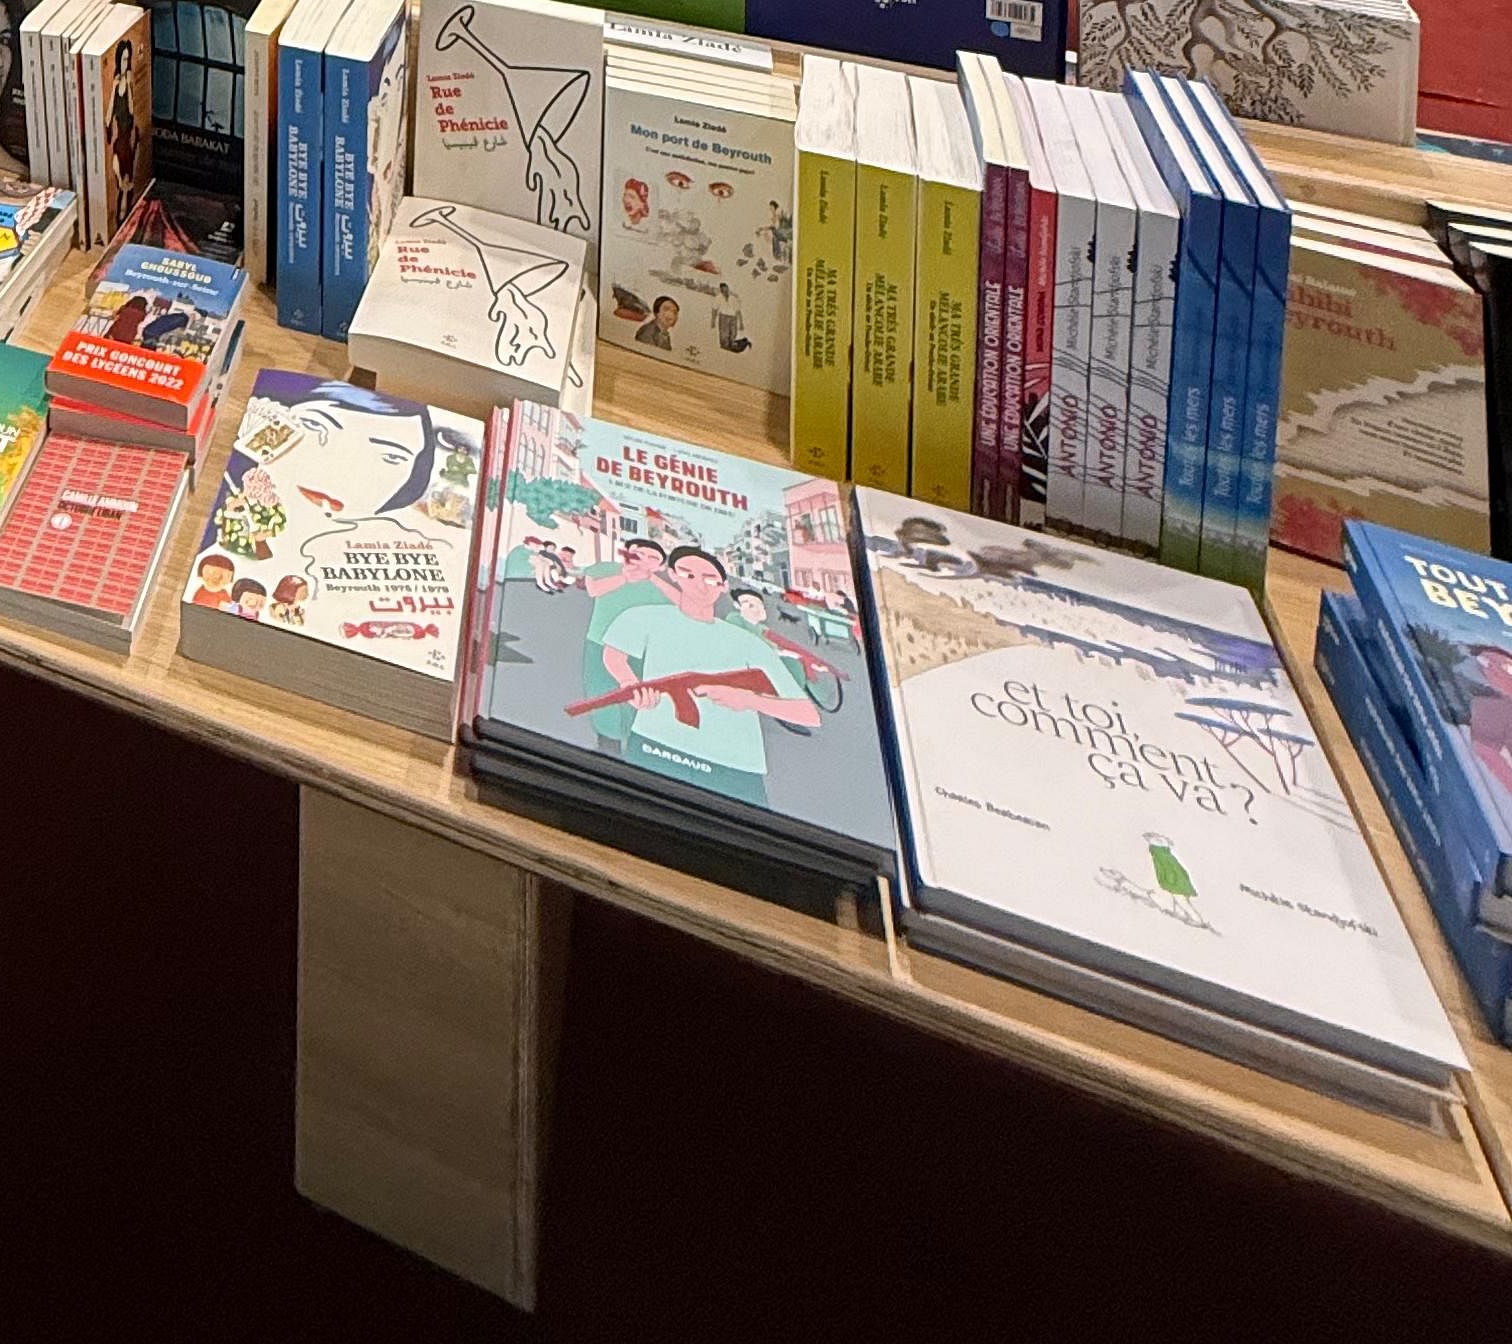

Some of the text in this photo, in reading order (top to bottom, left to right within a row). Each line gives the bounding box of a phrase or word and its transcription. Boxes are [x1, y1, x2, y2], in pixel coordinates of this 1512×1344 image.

[430, 86, 462, 99] Rue
[435, 103, 454, 116] de
[438, 117, 508, 133] Phénicie
[674, 115, 727, 134] Lamia Ziadé
[182, 133, 231, 154] BARAKAT
[631, 124, 772, 165] Mon port de Beyrouth
[288, 125, 299, 197] BABYLONE
[298, 143, 307, 199] BYE BYE
[335, 136, 345, 209] BABYLONE
[345, 154, 355, 211] BYE BYE
[397, 246, 430, 254] Rue
[398, 255, 418, 263] de
[400, 265, 477, 279] Phénicie
[985, 281, 1001, 348] ORIENTALE
[1007, 286, 1024, 352] ORIENTALE
[62, 352, 184, 390] DES LYCÉENS 2022
[77, 341, 182, 375] PRIX GONCOURT
[1188, 388, 1201, 420] mers
[1221, 396, 1235, 430] mers
[1255, 403, 1270, 436] mers
[982, 421, 997, 446] UNE
[1004, 426, 1020, 451] UNE
[1057, 394, 1078, 478] ANTONIO
[1099, 404, 1118, 490] ANTONIO
[623, 445, 648, 465] LE
[654, 454, 718, 484] GÉNIE
[1137, 413, 1157, 499] ANTONIO
[596, 456, 748, 511] DE BEYROUTH
[344, 552, 440, 566] BYE BYE
[346, 539, 433, 550] Lamia Ziadé
[320, 567, 445, 582] BABYLONE
[325, 583, 380, 594] Beyrouth
[1404, 555, 1508, 601] TOUT
[369, 596, 455, 616] بيروت
[1420, 578, 1512, 627] BEY
[1003, 679, 1140, 742] et toi,
[970, 692, 1228, 789] comment
[641, 743, 712, 773] DARGAUD
[1088, 752, 1258, 825] ça va ?
